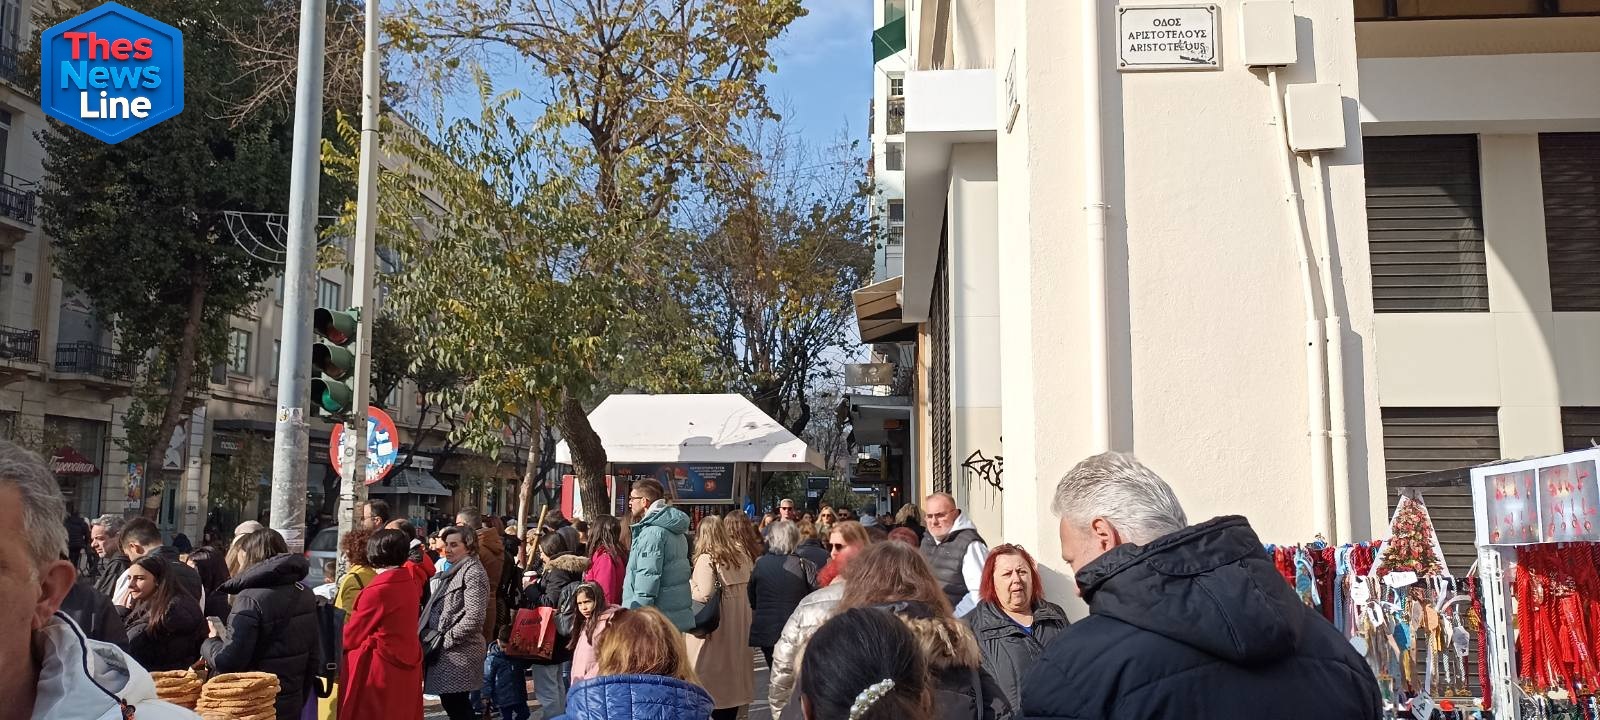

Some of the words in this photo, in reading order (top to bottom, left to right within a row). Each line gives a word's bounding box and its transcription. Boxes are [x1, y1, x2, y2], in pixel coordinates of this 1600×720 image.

[1153, 18, 1181, 27] ΟΔΟΣ
[1128, 30, 1206, 40] ΑΡΙΣΤΟΤΕΛΟΥΣ
[1129, 42, 1206, 52] ARISTOTELOUS
